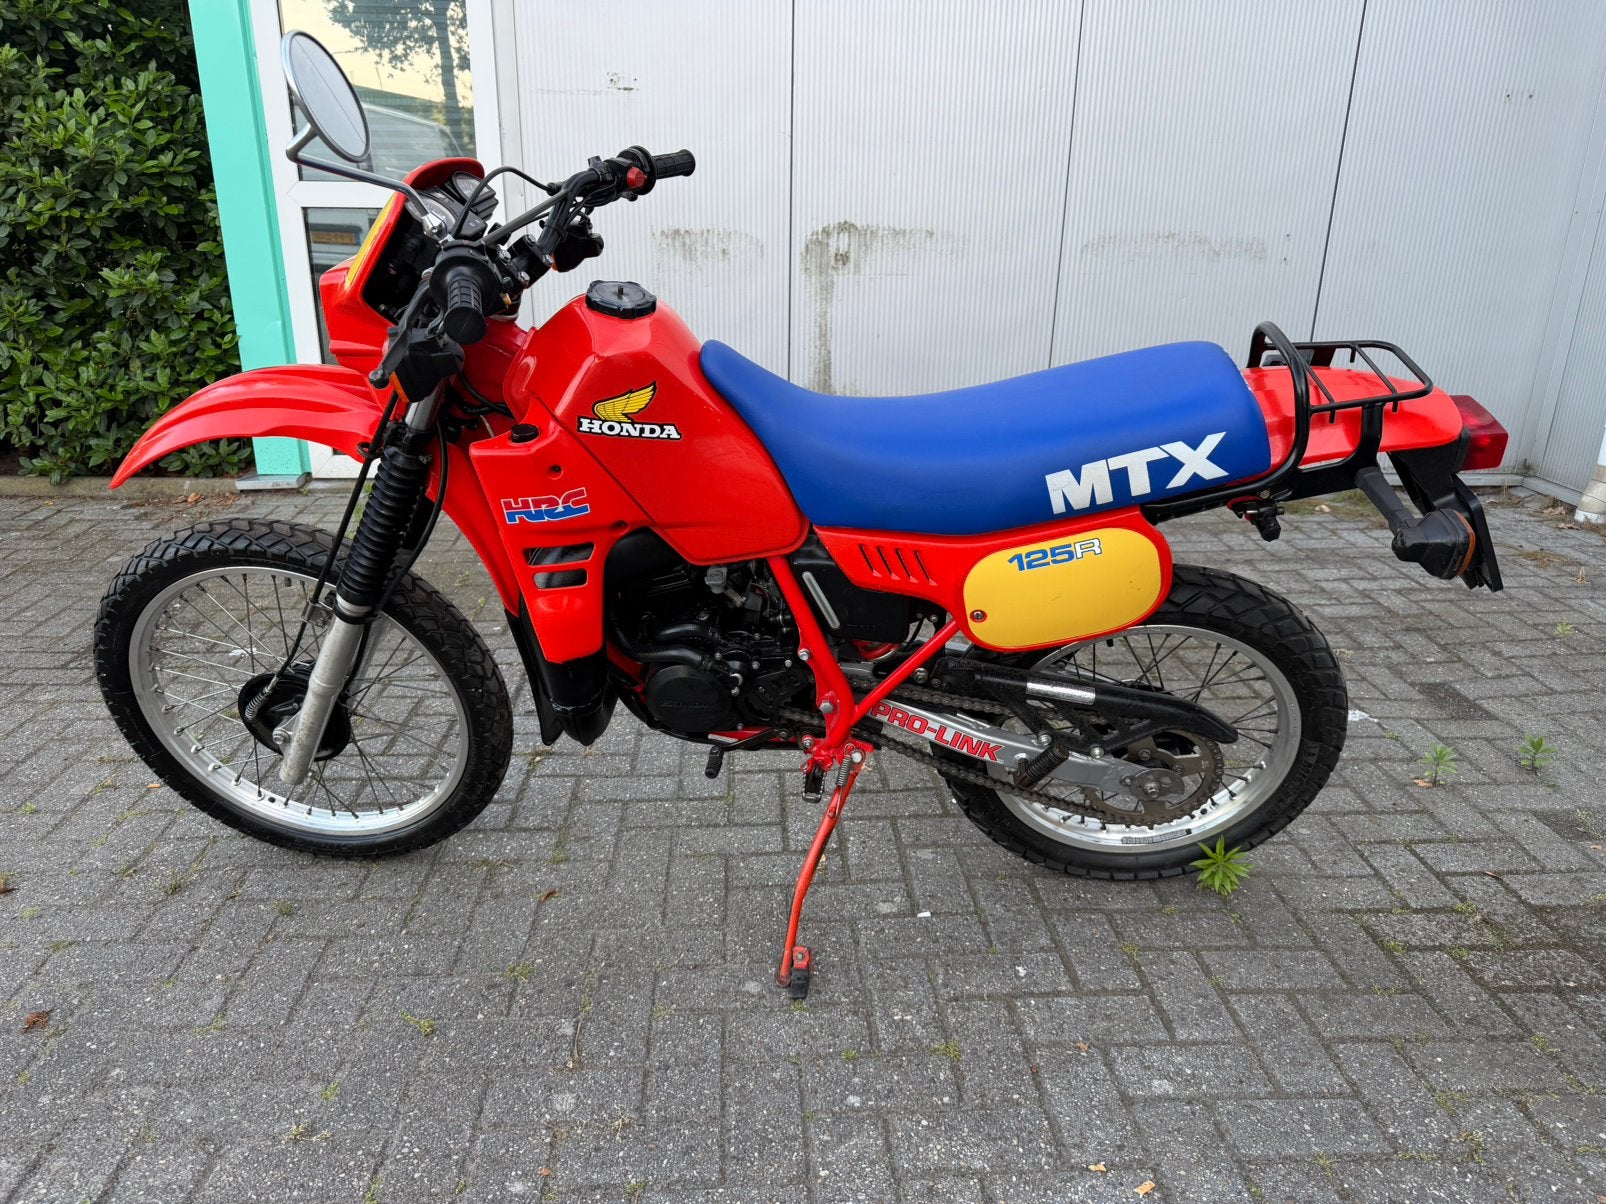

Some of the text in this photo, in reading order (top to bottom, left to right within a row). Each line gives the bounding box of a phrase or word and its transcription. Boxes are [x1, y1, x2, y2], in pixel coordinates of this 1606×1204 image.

[578, 416, 682, 440] HONDA
[1045, 431, 1230, 515] MTX
[500, 486, 591, 525] HRC
[1007, 537, 1103, 572] 125R
[869, 702, 1004, 763] PRO-LINK
